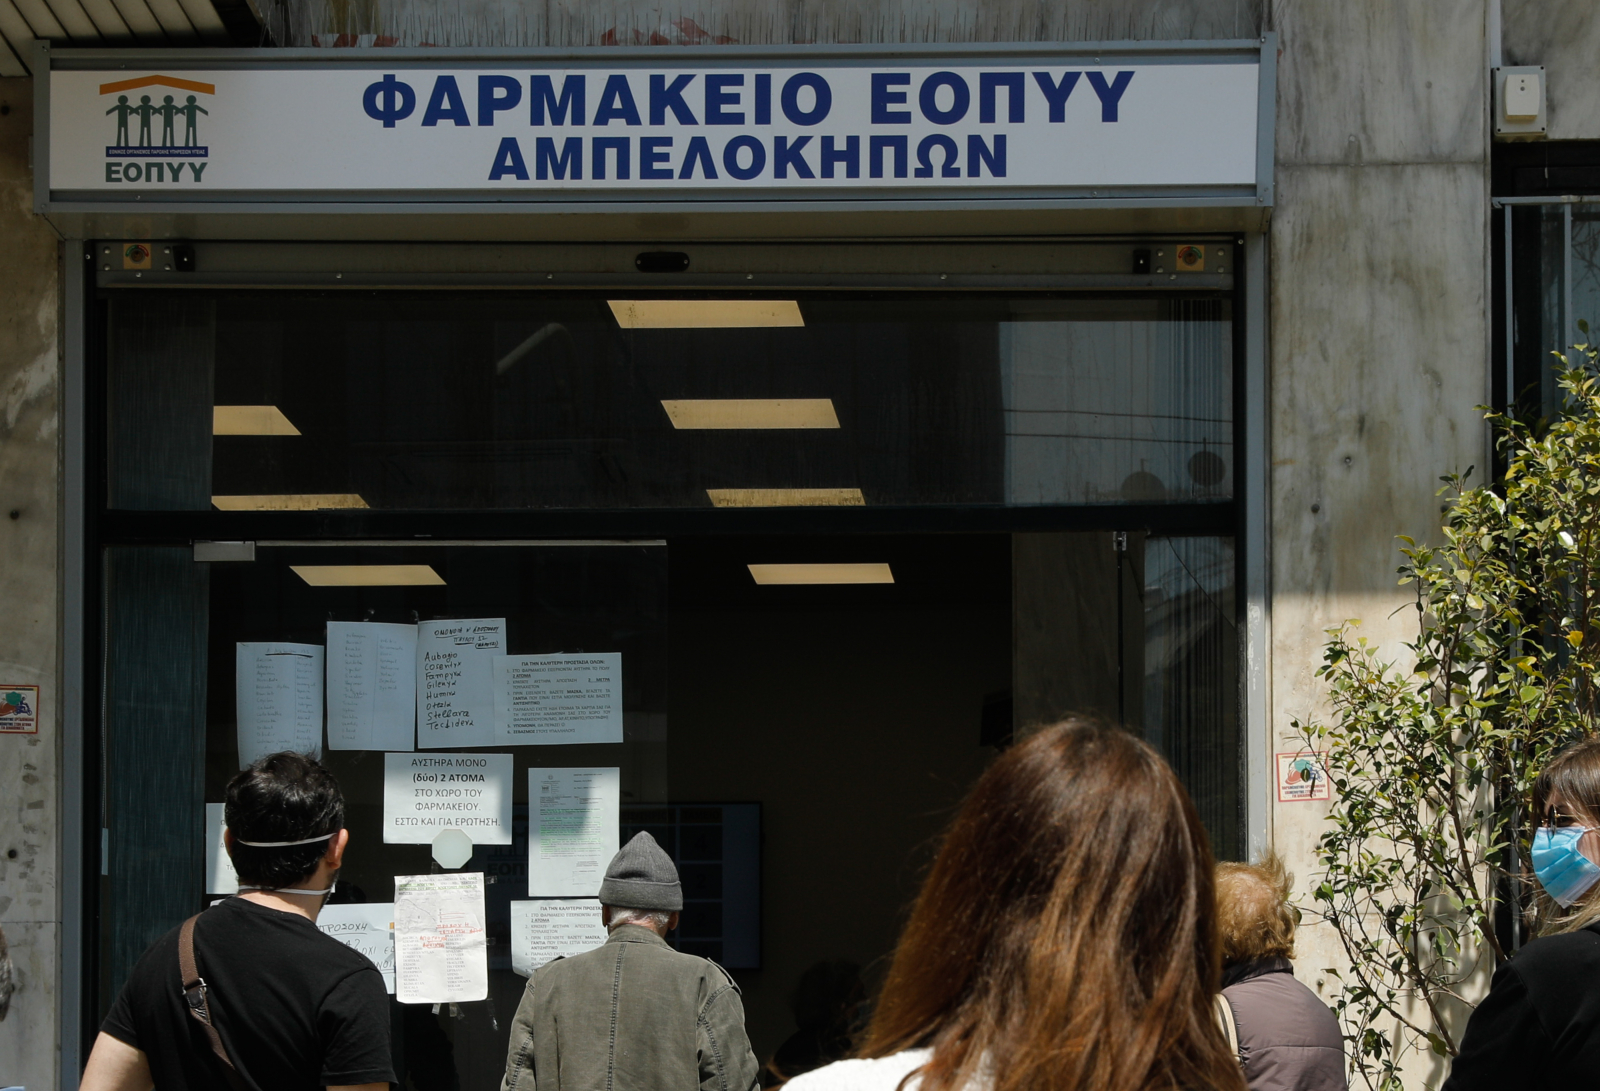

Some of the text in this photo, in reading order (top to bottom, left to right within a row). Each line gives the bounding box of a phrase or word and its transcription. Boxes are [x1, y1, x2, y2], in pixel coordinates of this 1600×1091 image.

[364, 71, 1134, 127] ΦΑΡΜΑΚΕΙΟ ΕΟΠΥΥ
[490, 134, 1006, 181] ΑΜΠΕΛΟΚΗΠΩΝ
[105, 162, 208, 183] ΕΟΠΥΥ
[411, 758, 487, 768] ΑΥΣΤΗΡΑ ΜΟΝΟ
[413, 773, 486, 784] (δύο) 2 ΑΤΟΜΑ
[414, 788, 483, 798] ΣΤΟ ΧΩΡΟ ΤΟΥ
[414, 802, 481, 812] ΦΑΡΜΑΚΕΙΟΥ.
[394, 817, 501, 827] ΕΣΤΩ ΚΑΙ ΓΙΑ ΕΡΩΤΗΣΗ.
